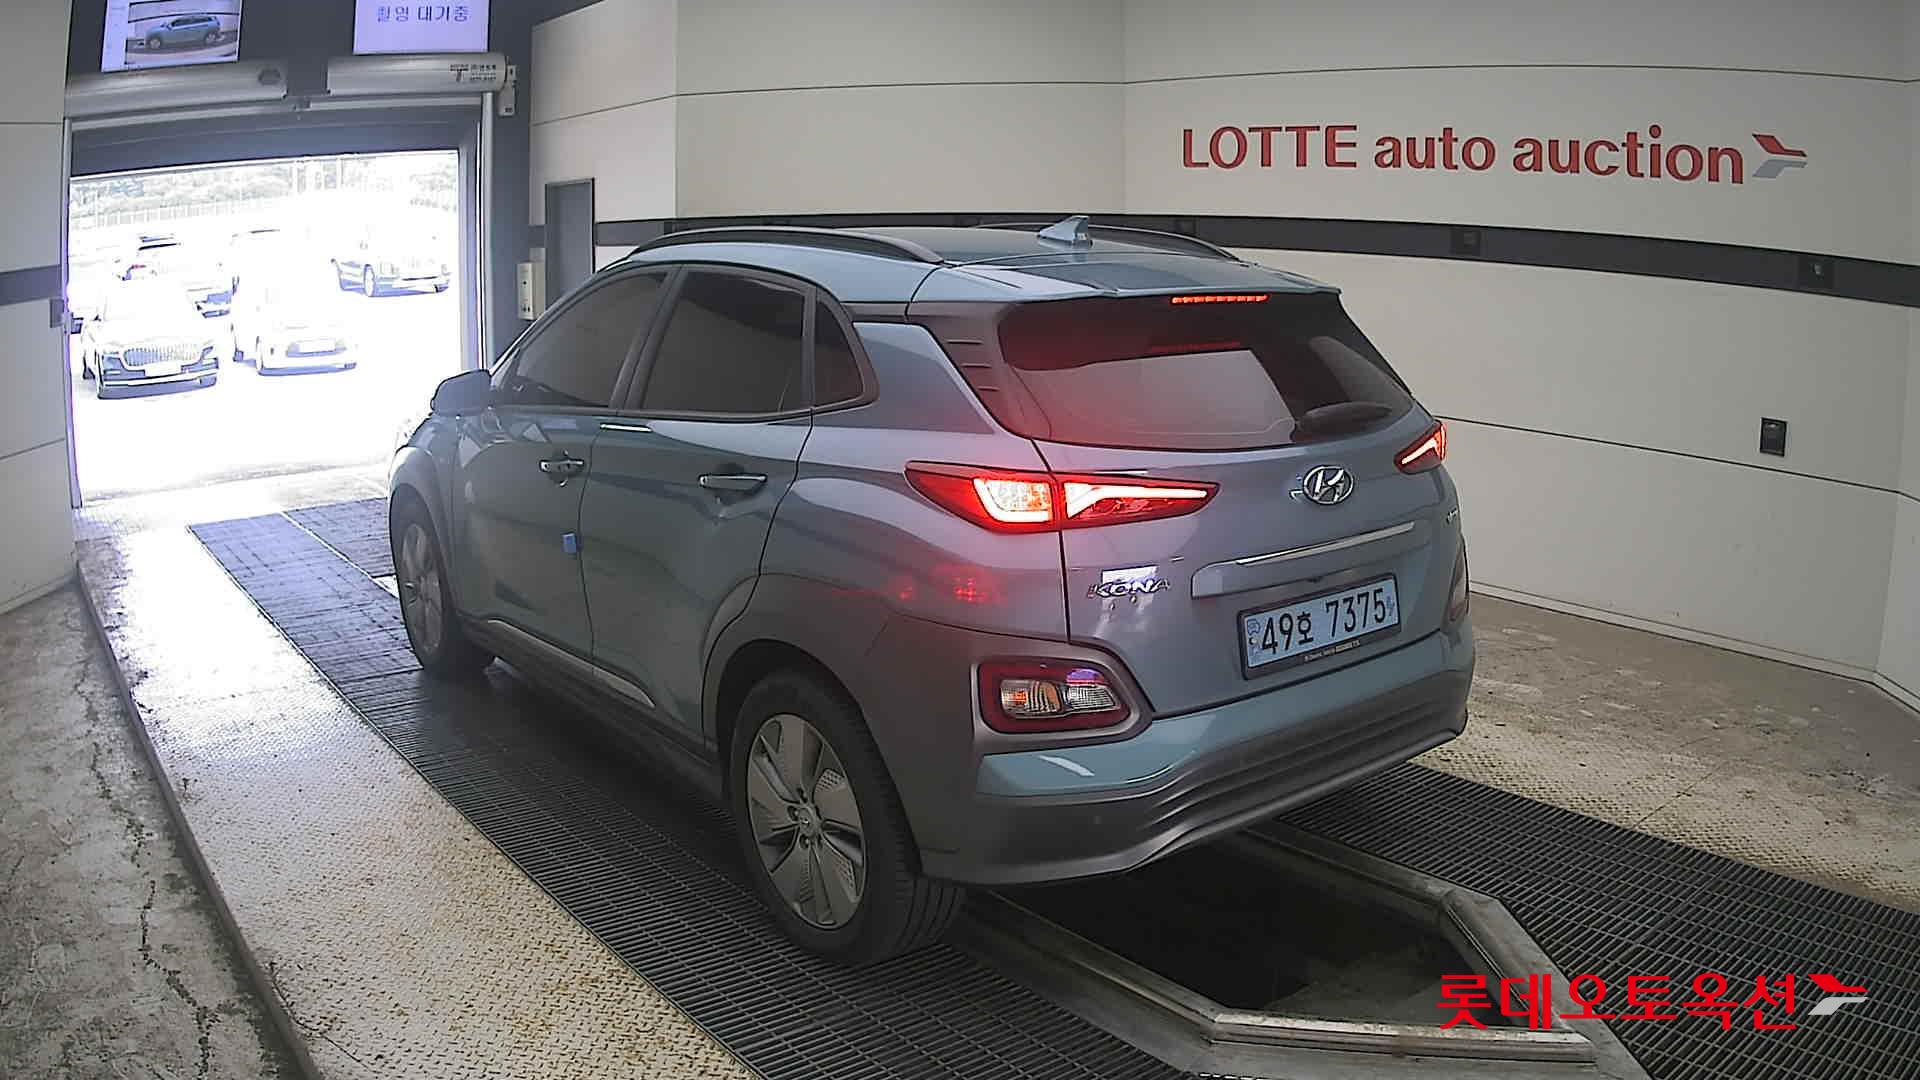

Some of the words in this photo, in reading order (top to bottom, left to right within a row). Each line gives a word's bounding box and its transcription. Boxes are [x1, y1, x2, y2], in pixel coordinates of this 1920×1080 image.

[417, 5, 469, 22] 대기중
[1183, 124, 1357, 169] LOTTE
[1374, 127, 1496, 171] auto
[1512, 124, 1744, 184] auction
[1087, 578, 1170, 599] KONA
[1261, 611, 1314, 654] 49호
[1325, 588, 1386, 638] 7375
